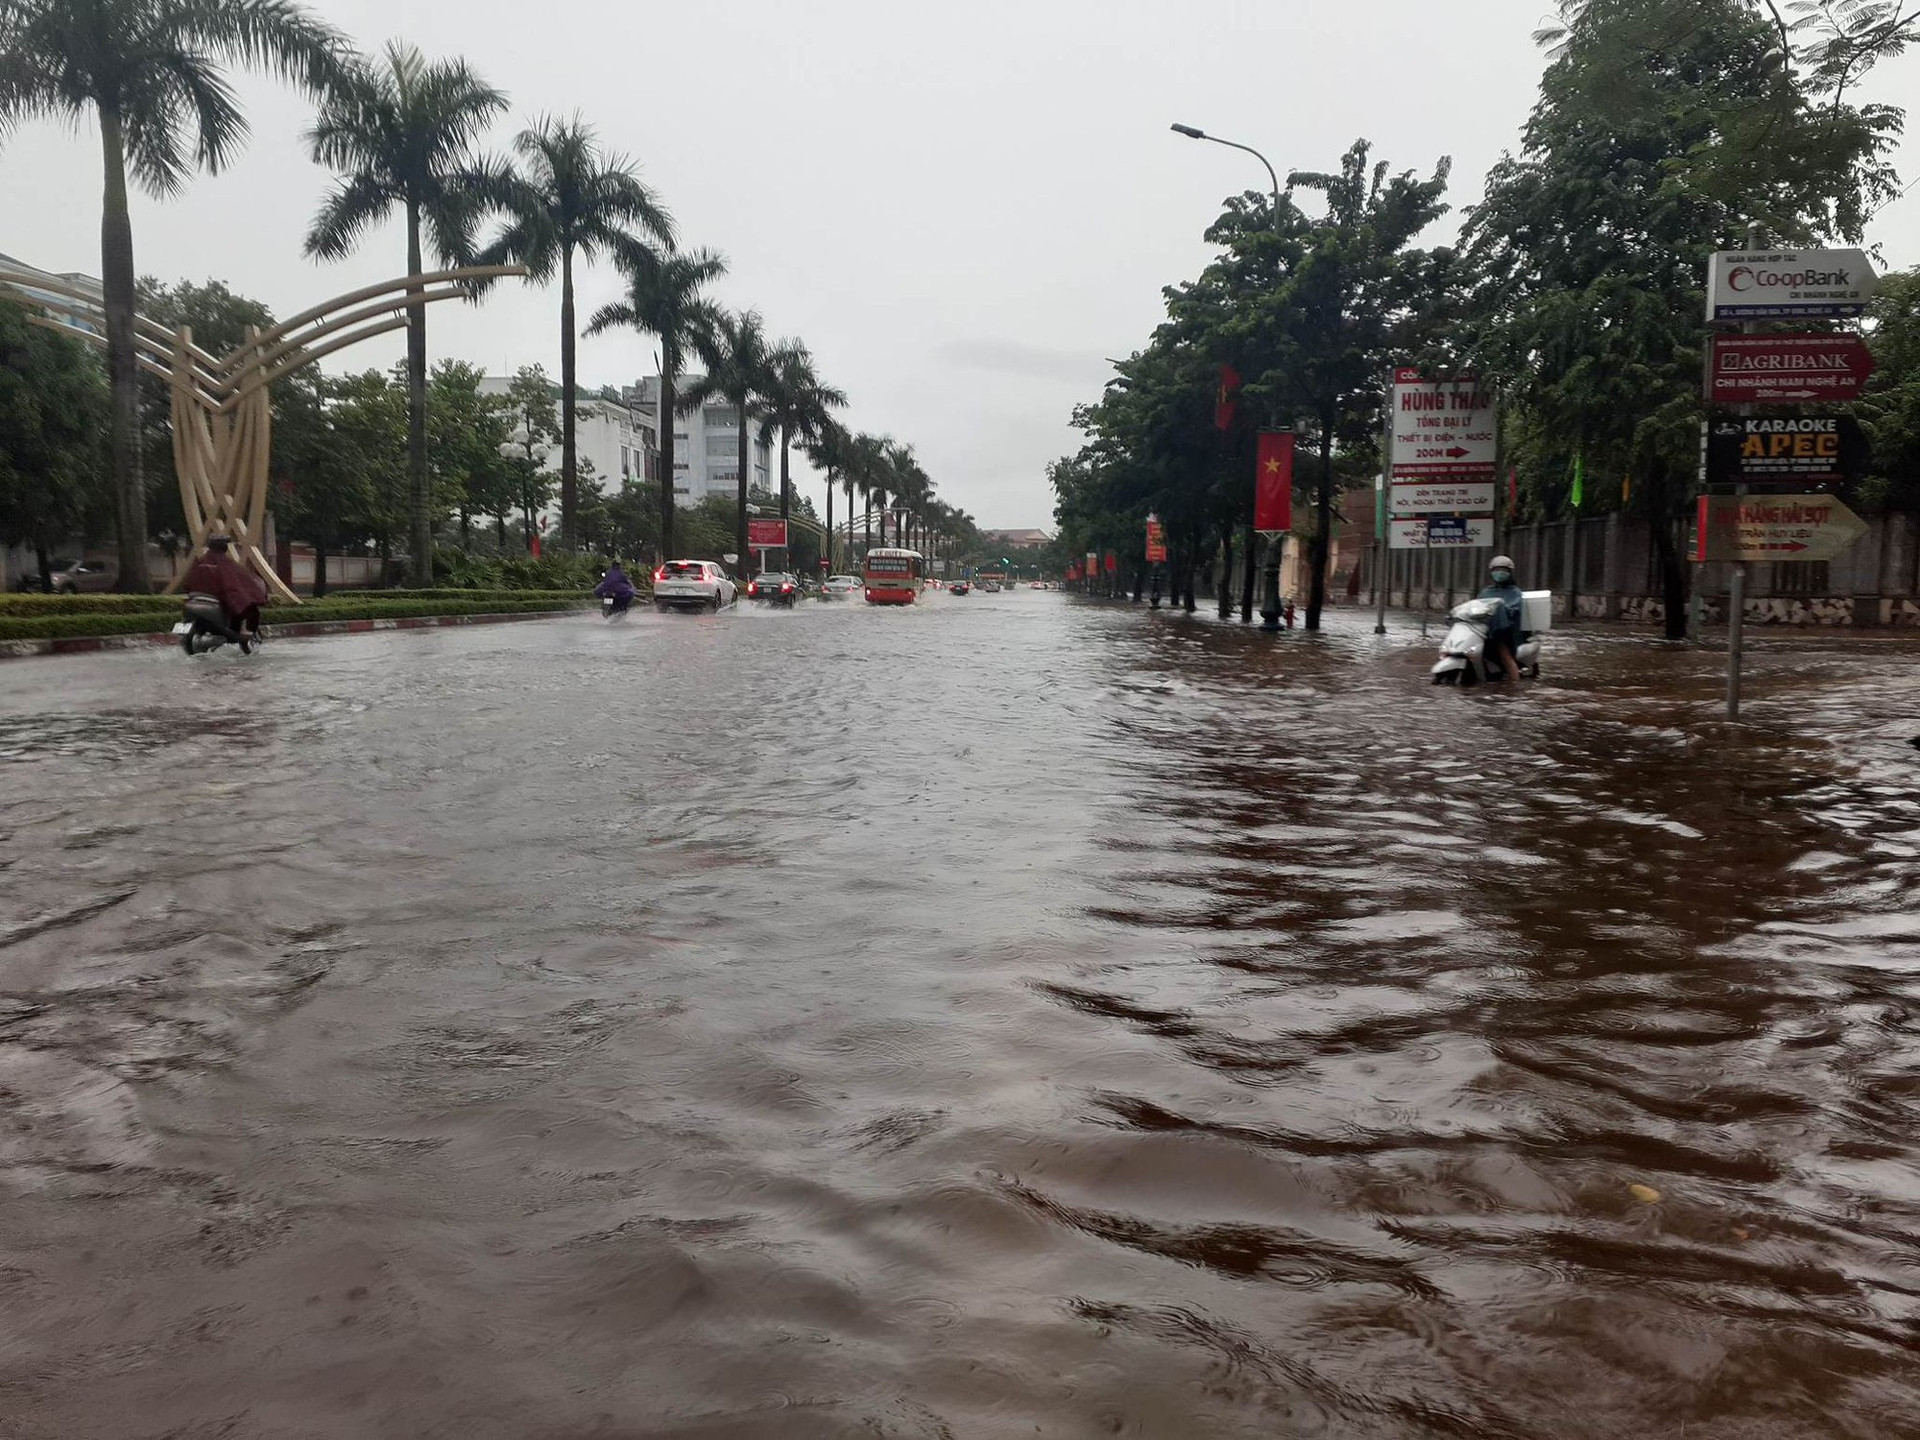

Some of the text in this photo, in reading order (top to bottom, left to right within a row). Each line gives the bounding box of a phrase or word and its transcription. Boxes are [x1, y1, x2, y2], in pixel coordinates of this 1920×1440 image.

[1740, 353, 1850, 369] AGRIBANK
[1716, 375, 1856, 388] CHI NHÁNH NAM NGHỆ AN
[1402, 388, 1445, 411] HÙNG
[1745, 419, 1837, 433] KARAOKE
[1740, 433, 1839, 457] APEC
